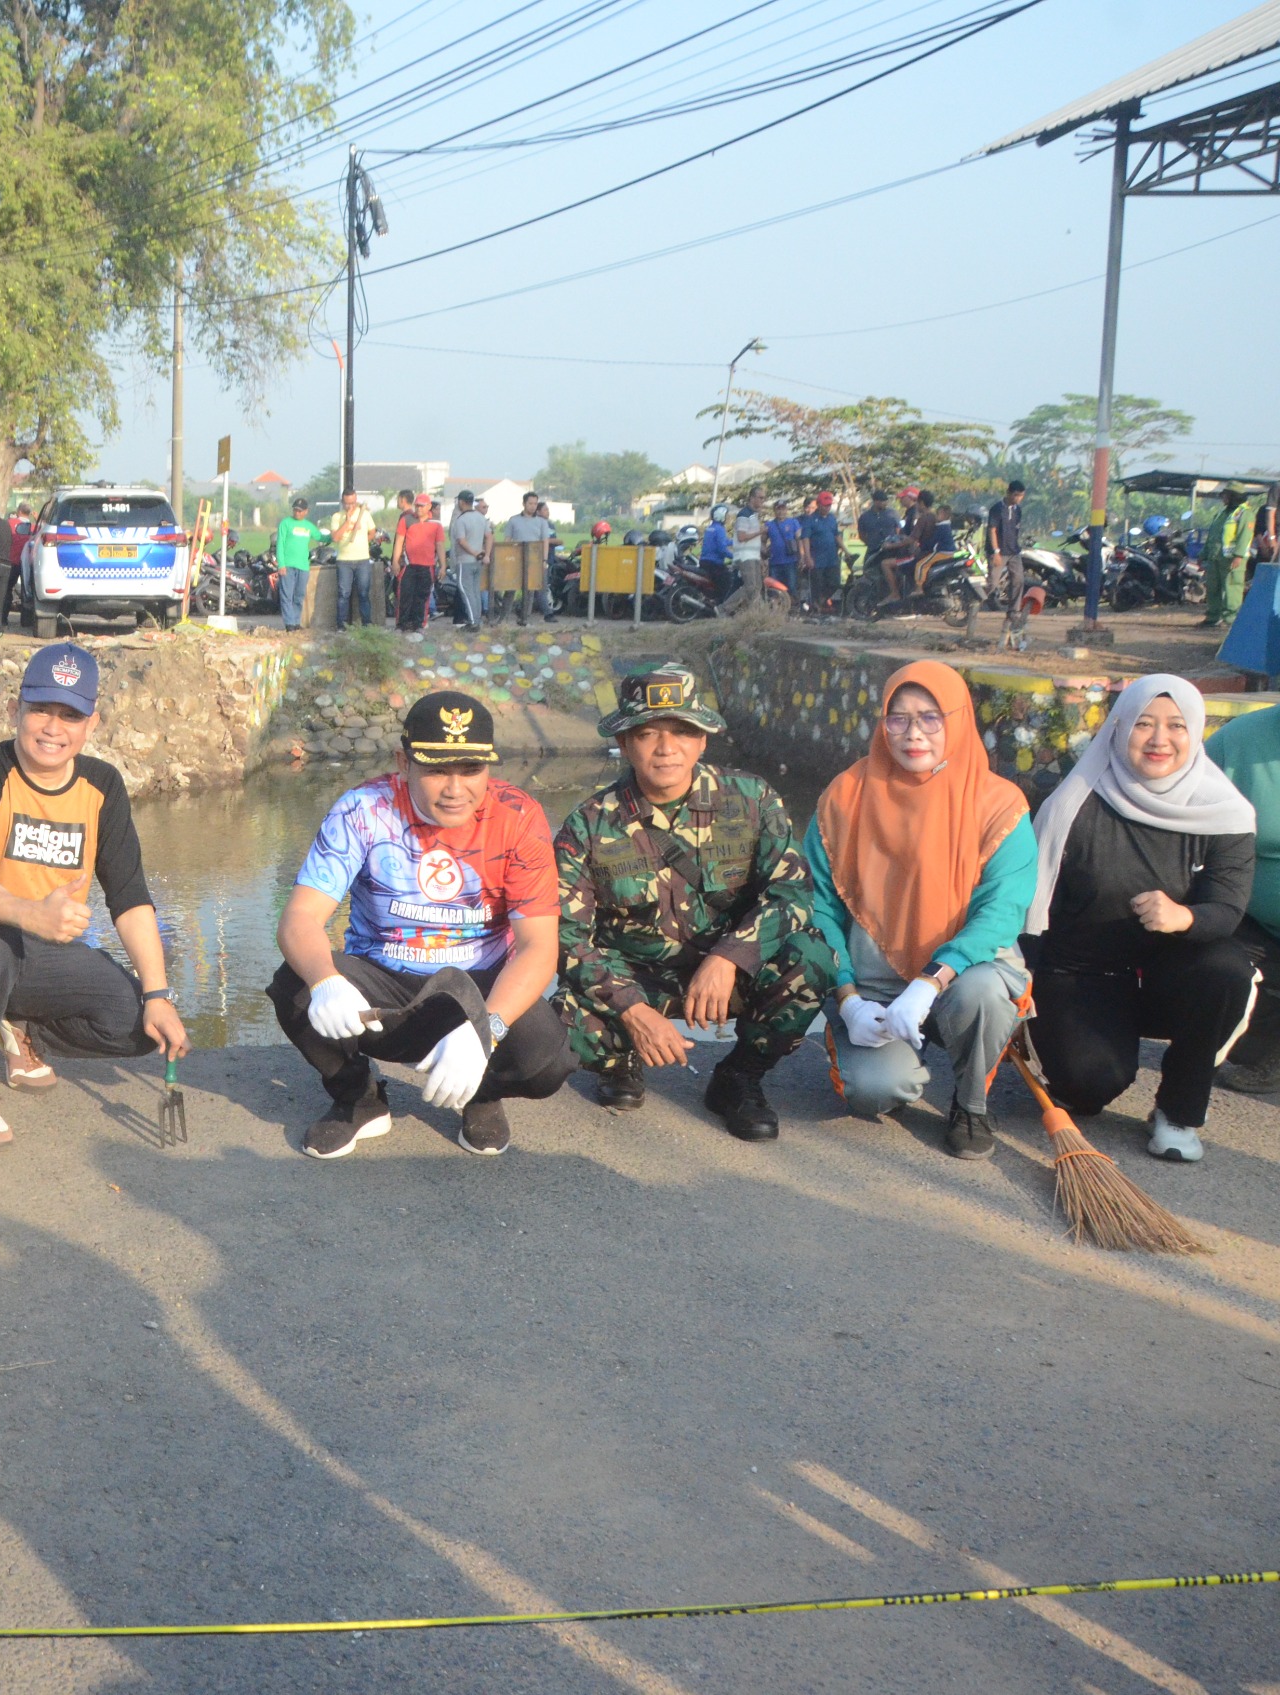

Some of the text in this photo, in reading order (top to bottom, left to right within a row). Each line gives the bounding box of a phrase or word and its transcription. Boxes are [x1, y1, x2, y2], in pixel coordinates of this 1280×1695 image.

[389, 899, 464, 924] BHAYANGKARA
[464, 907, 486, 924] RUN
[382, 942, 427, 963] POLRESTA
